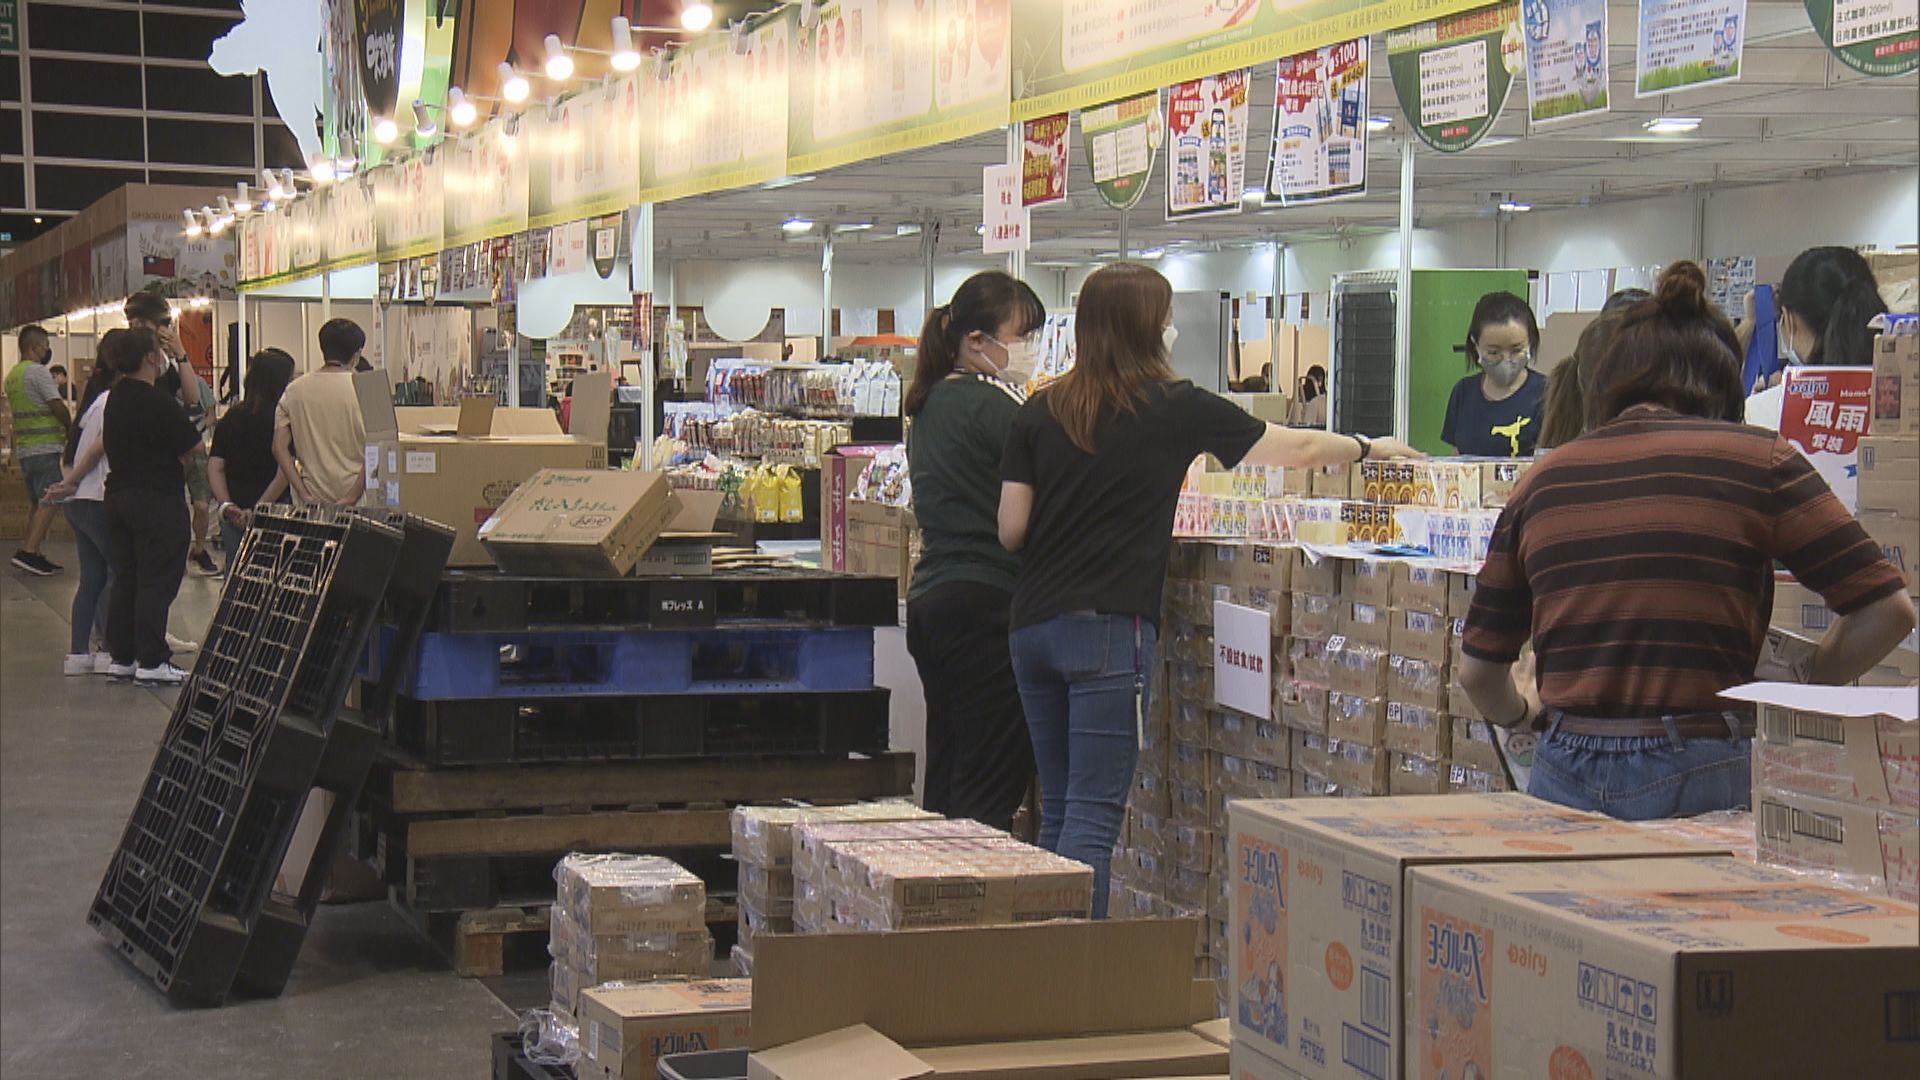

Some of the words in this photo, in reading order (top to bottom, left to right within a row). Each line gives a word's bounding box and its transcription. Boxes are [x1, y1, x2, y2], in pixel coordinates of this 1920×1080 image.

[1804, 400, 1868, 433] 風雨
[1219, 644, 1263, 673] 不設試食/試飲
[1607, 1022, 1656, 1058] 乳性飲料
